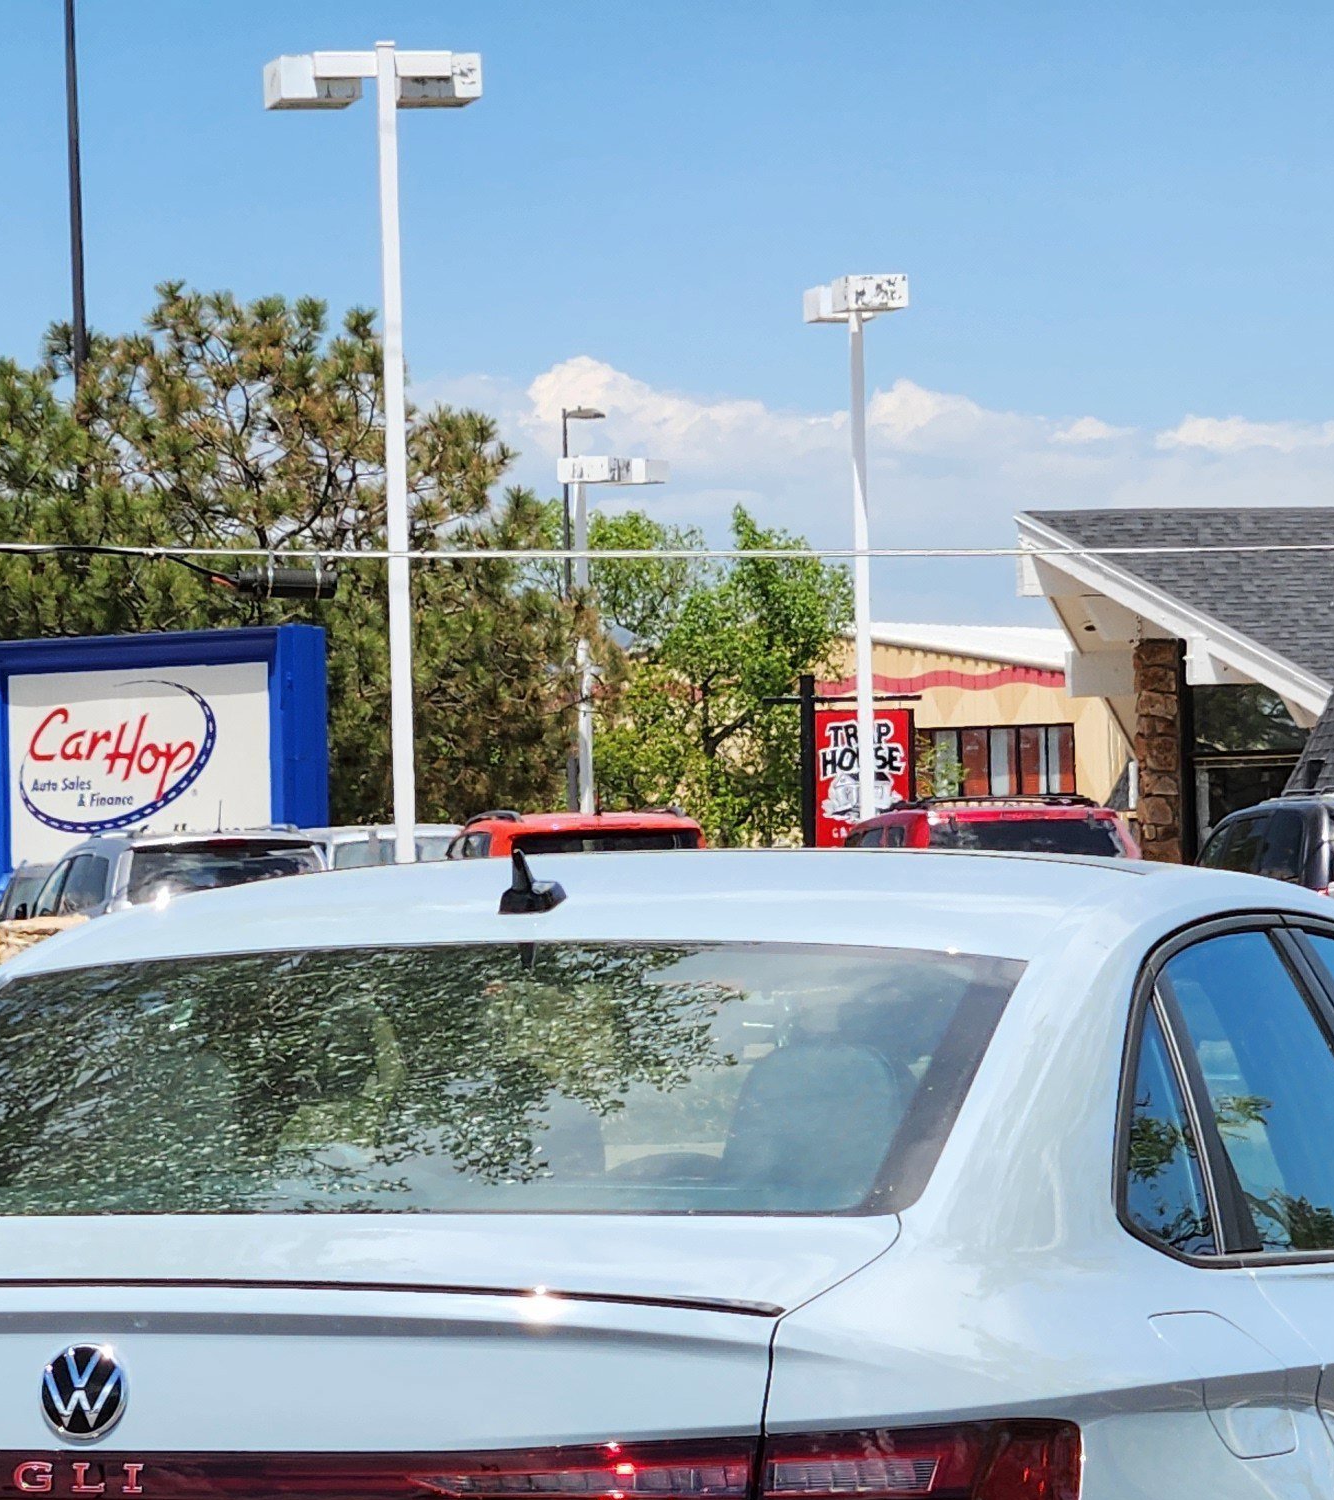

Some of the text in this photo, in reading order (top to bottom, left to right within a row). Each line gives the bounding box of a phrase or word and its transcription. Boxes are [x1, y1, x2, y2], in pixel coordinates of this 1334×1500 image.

[828, 723, 891, 748] TRP
[28, 707, 196, 802] CarHop
[821, 746, 903, 778] HOSE
[31, 775, 92, 792] Auto Sales
[89, 791, 135, 808] Finance
[14, 1461, 145, 1494] GLI
